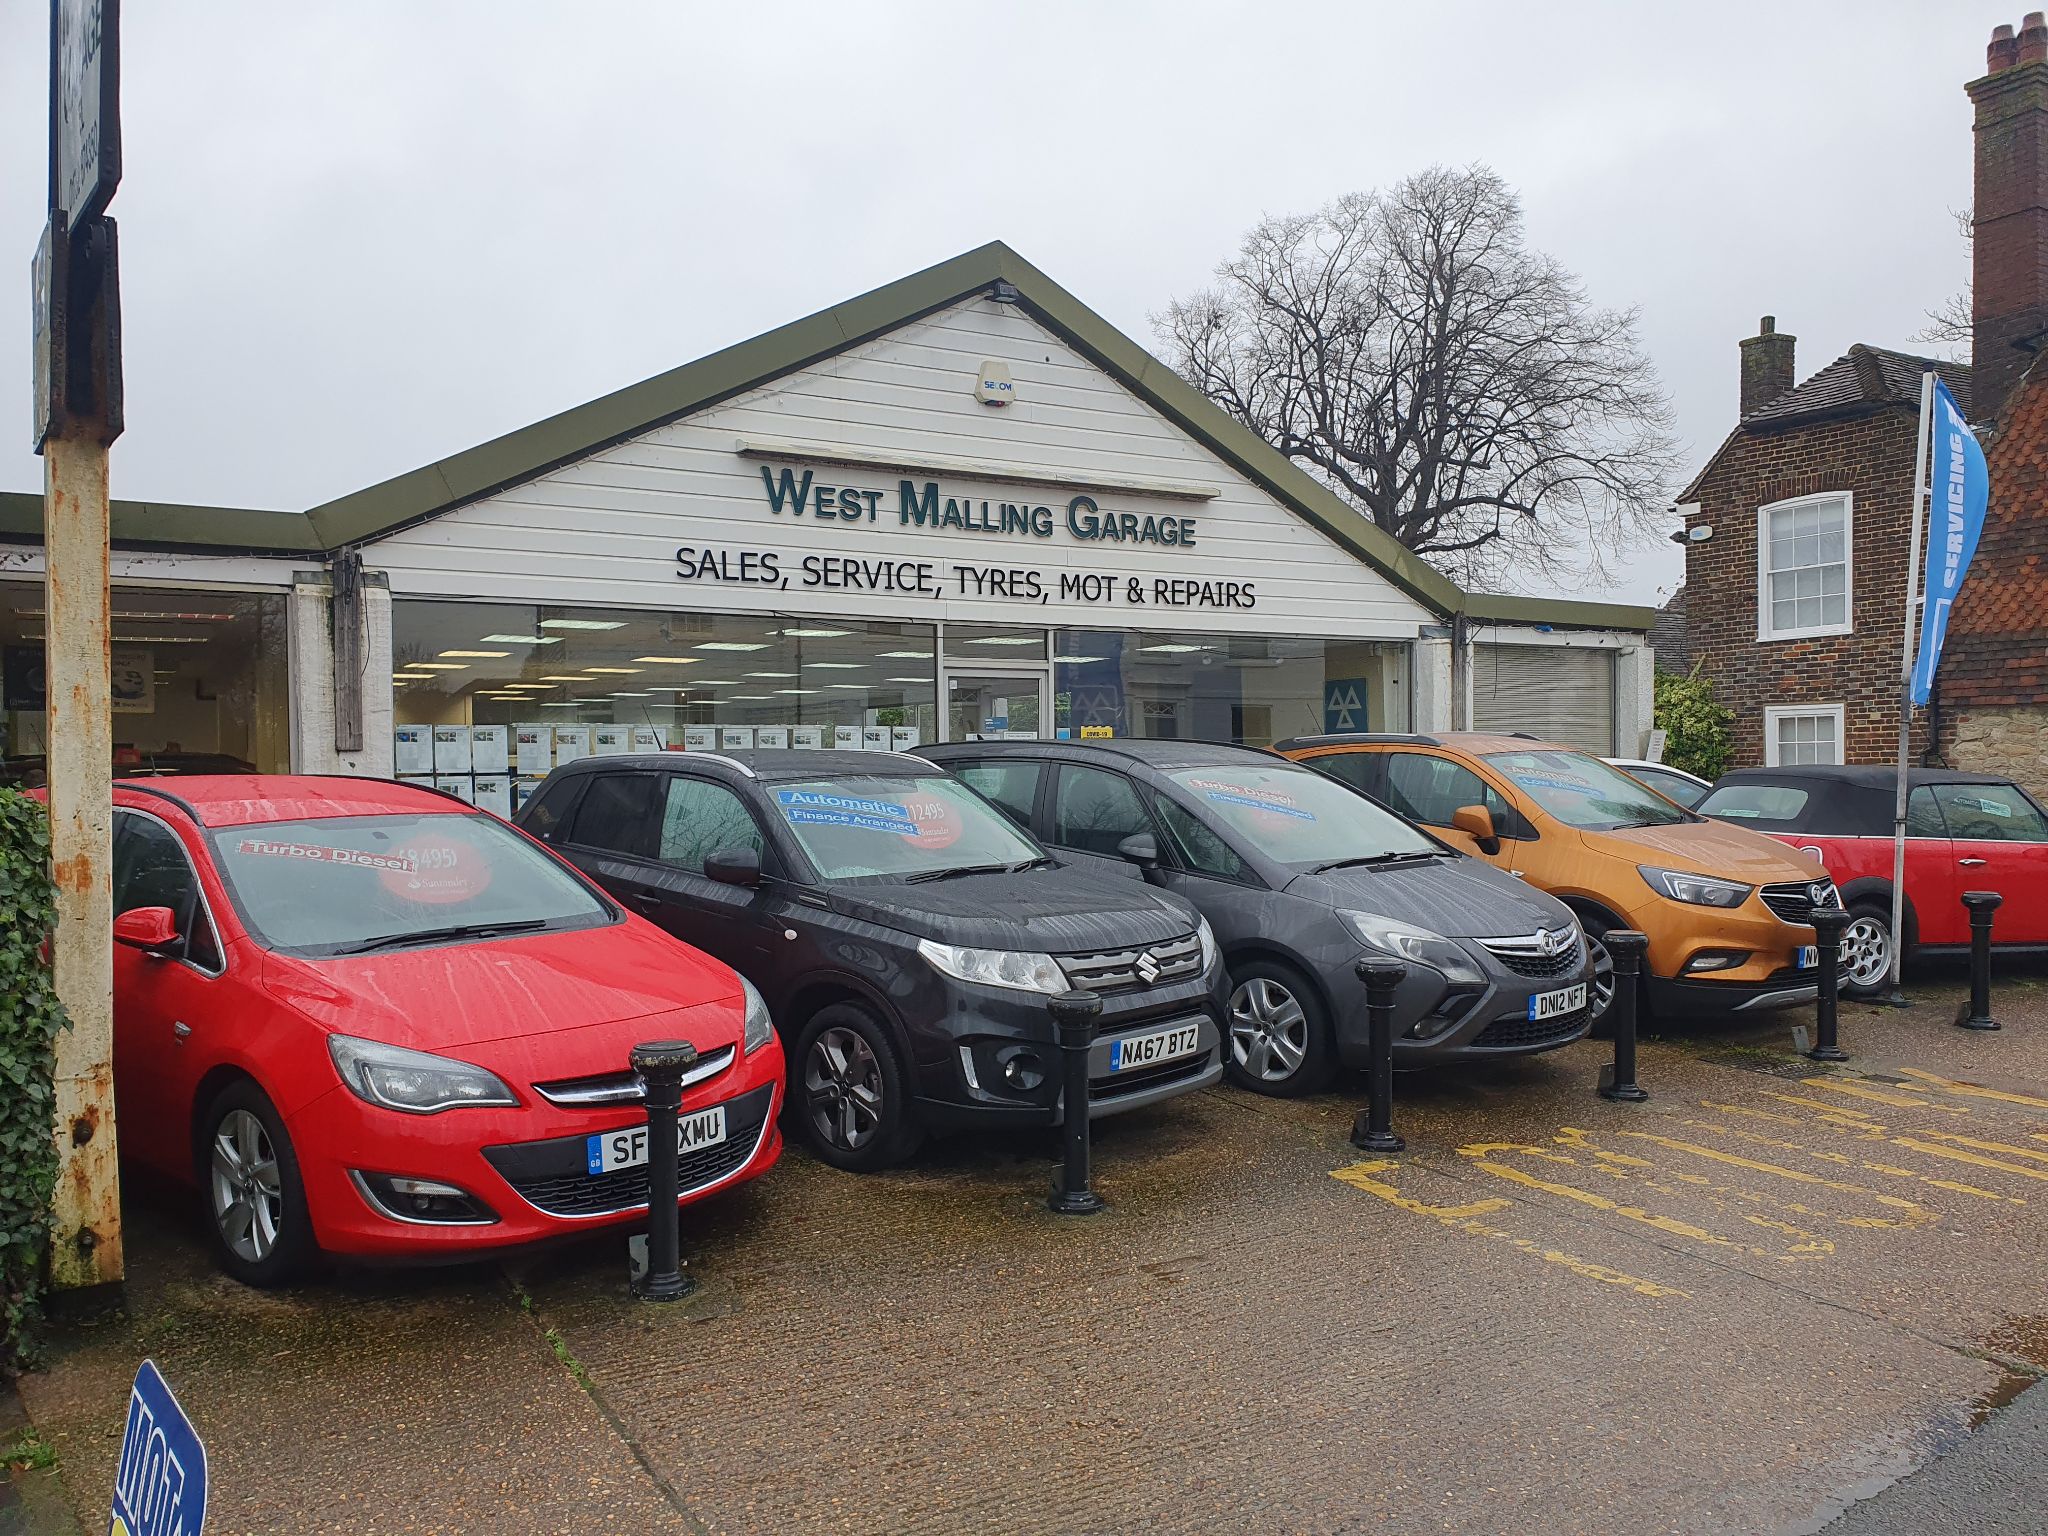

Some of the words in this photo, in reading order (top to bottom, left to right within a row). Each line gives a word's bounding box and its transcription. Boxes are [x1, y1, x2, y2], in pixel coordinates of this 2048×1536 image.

[984, 380, 1012, 391] SECOM
[760, 465, 884, 522] WEST
[899, 480, 1053, 537] MALLING
[1066, 495, 1197, 546] GARAGE
[1943, 431, 1965, 589] SERVICING
[676, 547, 789, 590] SALES,
[802, 556, 943, 598] SERVICE,
[953, 565, 1049, 604] TYRES,
[1060, 573, 1118, 602] MOT
[1127, 577, 1145, 604] &
[1154, 580, 1256, 608] REPAIRS
[1512, 766, 1587, 784] Automatic
[790, 792, 899, 815] Automatic
[910, 803, 945, 820] 12495
[793, 810, 849, 822] Finance
[854, 816, 914, 833] Arranged
[250, 841, 322, 859] Turbo
[332, 849, 409, 871] Diesel
[1540, 992, 1565, 1015] DN12
[1567, 986, 1584, 1008] NFT
[1121, 1035, 1165, 1065] NA67
[1167, 1028, 1196, 1054] BTZ
[612, 1131, 650, 1164] SF
[677, 1112, 720, 1150] XMU
